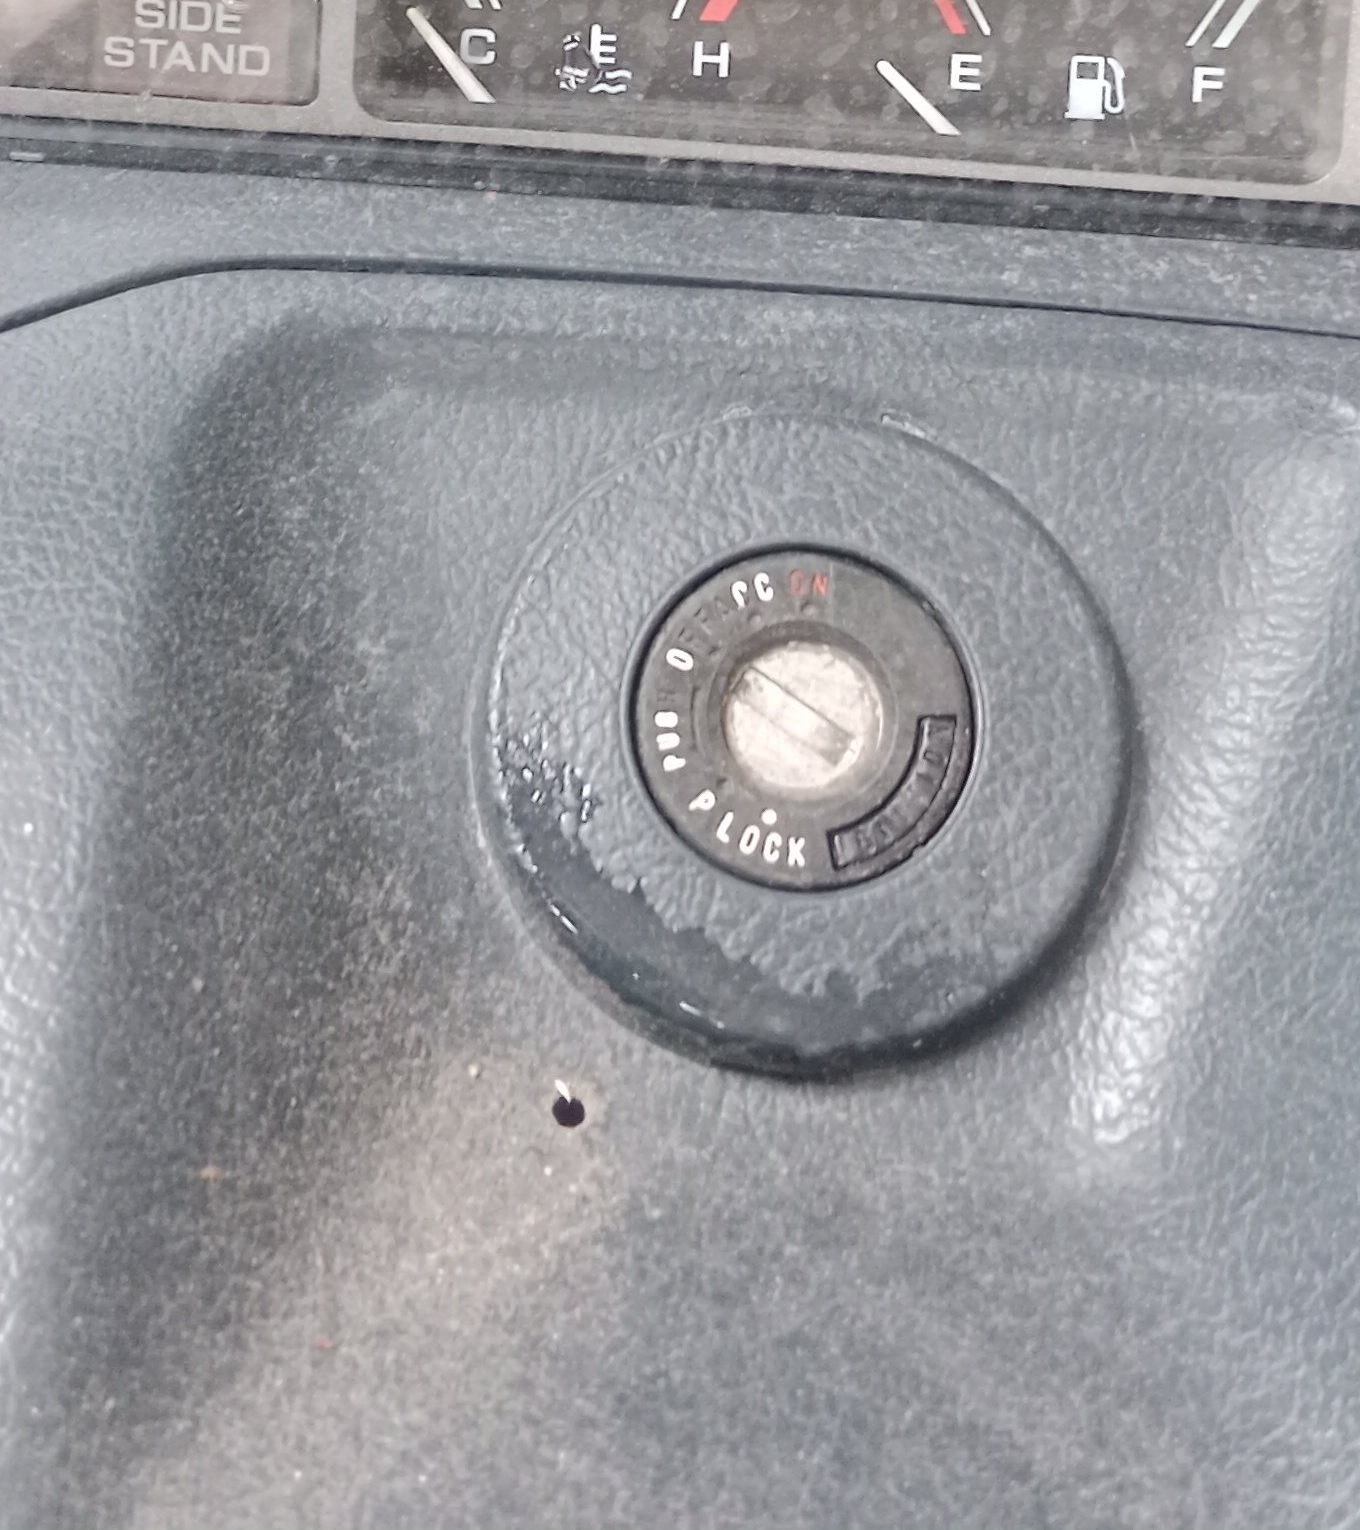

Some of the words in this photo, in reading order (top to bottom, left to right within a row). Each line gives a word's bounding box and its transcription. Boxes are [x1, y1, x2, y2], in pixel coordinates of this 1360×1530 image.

[103, 35, 271, 78] STAND
[457, 27, 497, 66] C
[691, 42, 731, 79] H
[948, 52, 982, 91] E
[1191, 67, 1225, 104] F
[688, 788, 717, 812] P
[715, 811, 806, 868] LOCK
